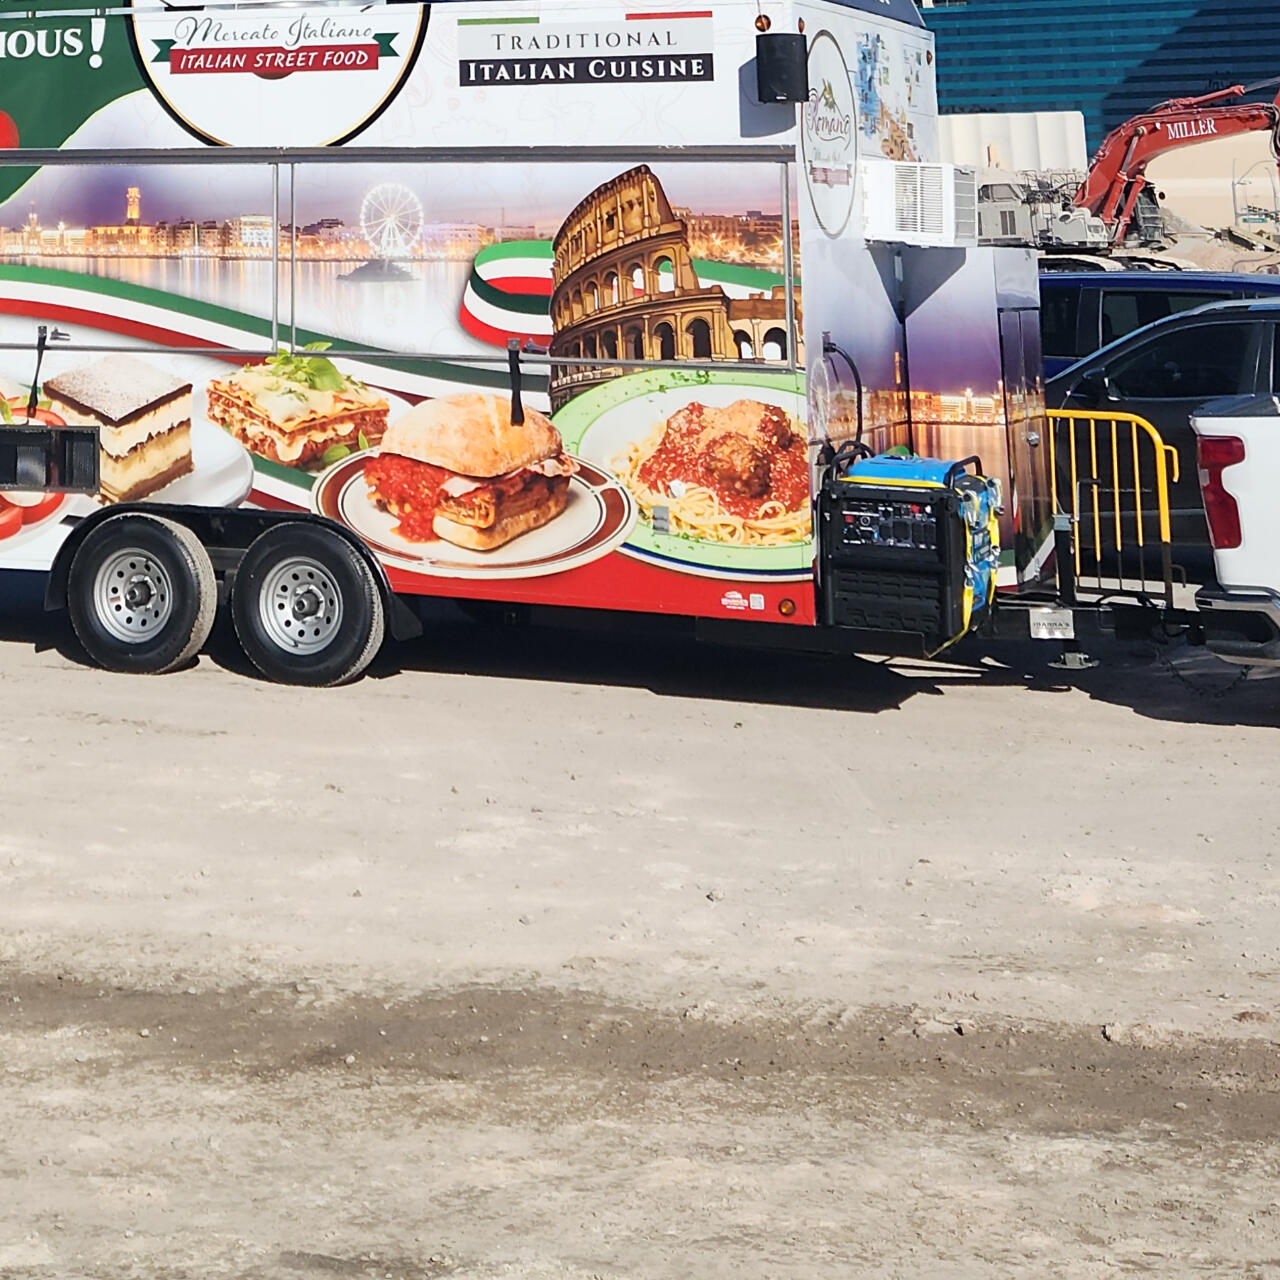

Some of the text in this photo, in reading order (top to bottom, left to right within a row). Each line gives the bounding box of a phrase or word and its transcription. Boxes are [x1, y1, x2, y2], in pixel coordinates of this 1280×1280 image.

[174, 13, 373, 47] Mercato Italiano
[491, 31, 678, 51] TRADITIONAL
[180, 50, 369, 70] ITALIAN STREET FOOD
[468, 58, 705, 81] ITALIAN CUISINE
[1166, 117, 1218, 140] MILLER
